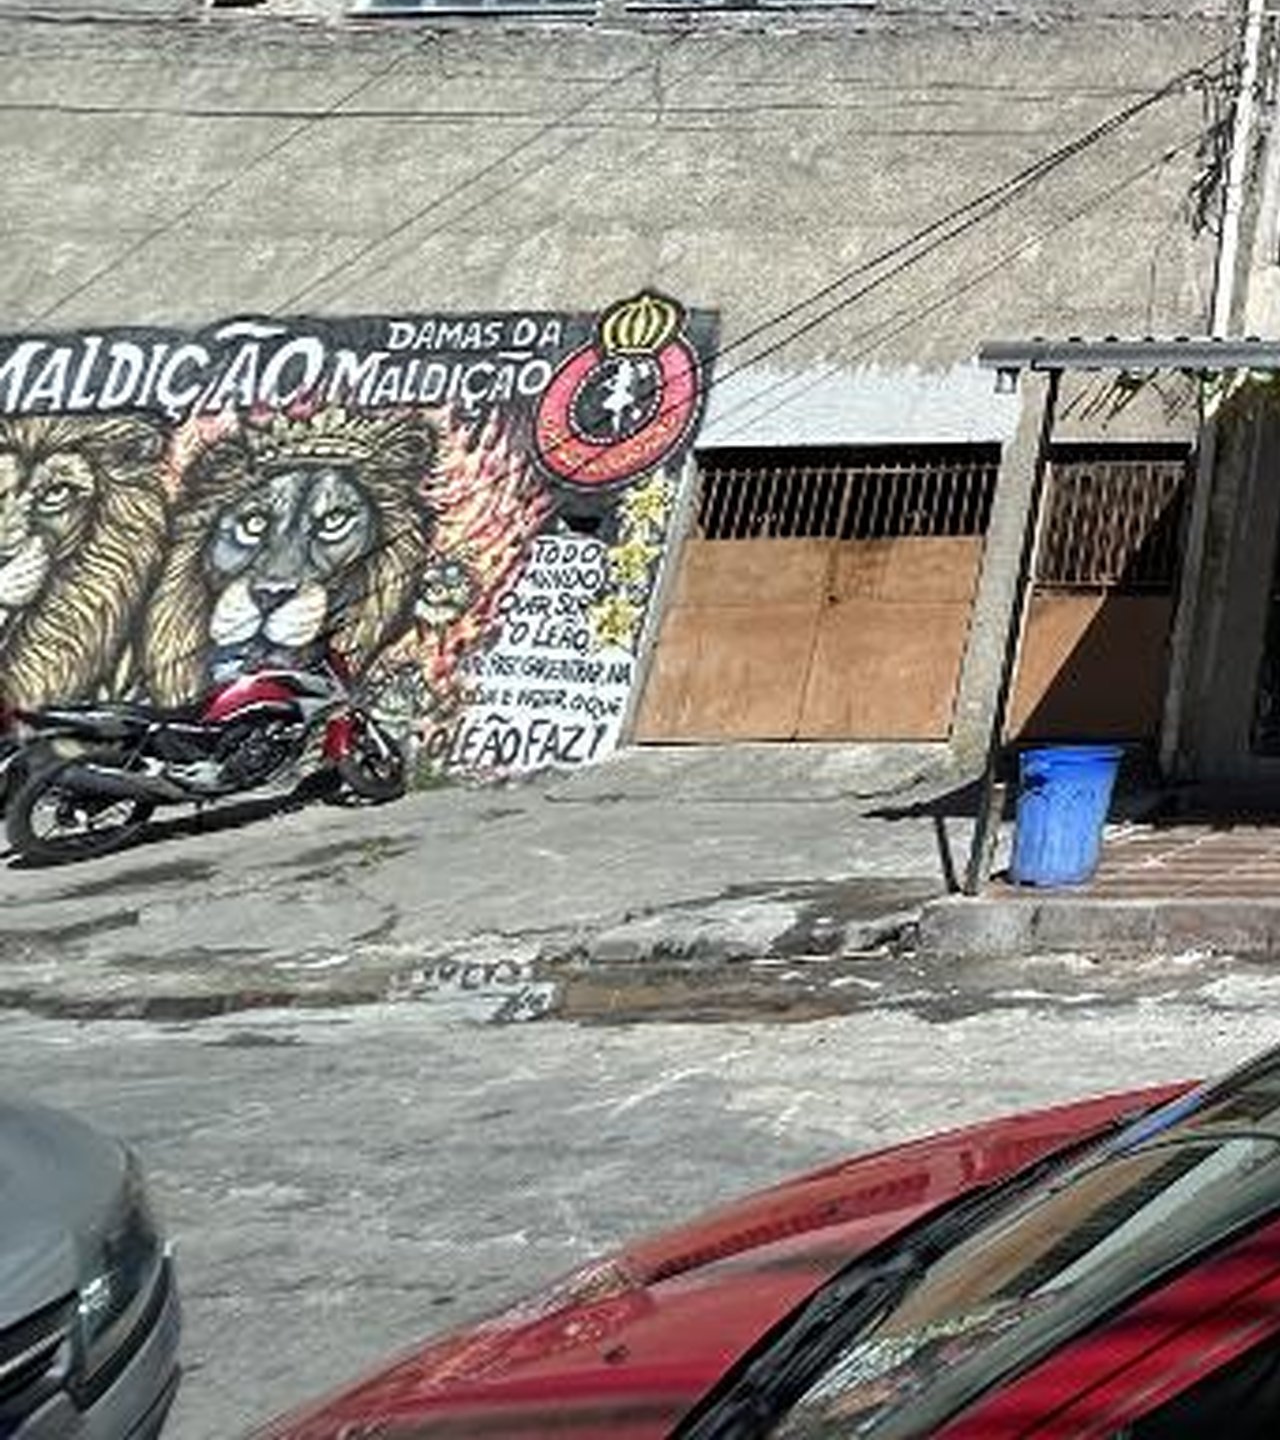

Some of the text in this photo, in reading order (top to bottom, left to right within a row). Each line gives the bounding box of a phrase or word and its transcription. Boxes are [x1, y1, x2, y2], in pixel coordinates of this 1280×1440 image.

[388, 320, 561, 350] DAMAS DA
[327, 349, 552, 417] MALDIÇÃO
[536, 539, 602, 565] TODO
[525, 565, 601, 590] MUNDO
[509, 622, 530, 647] O
